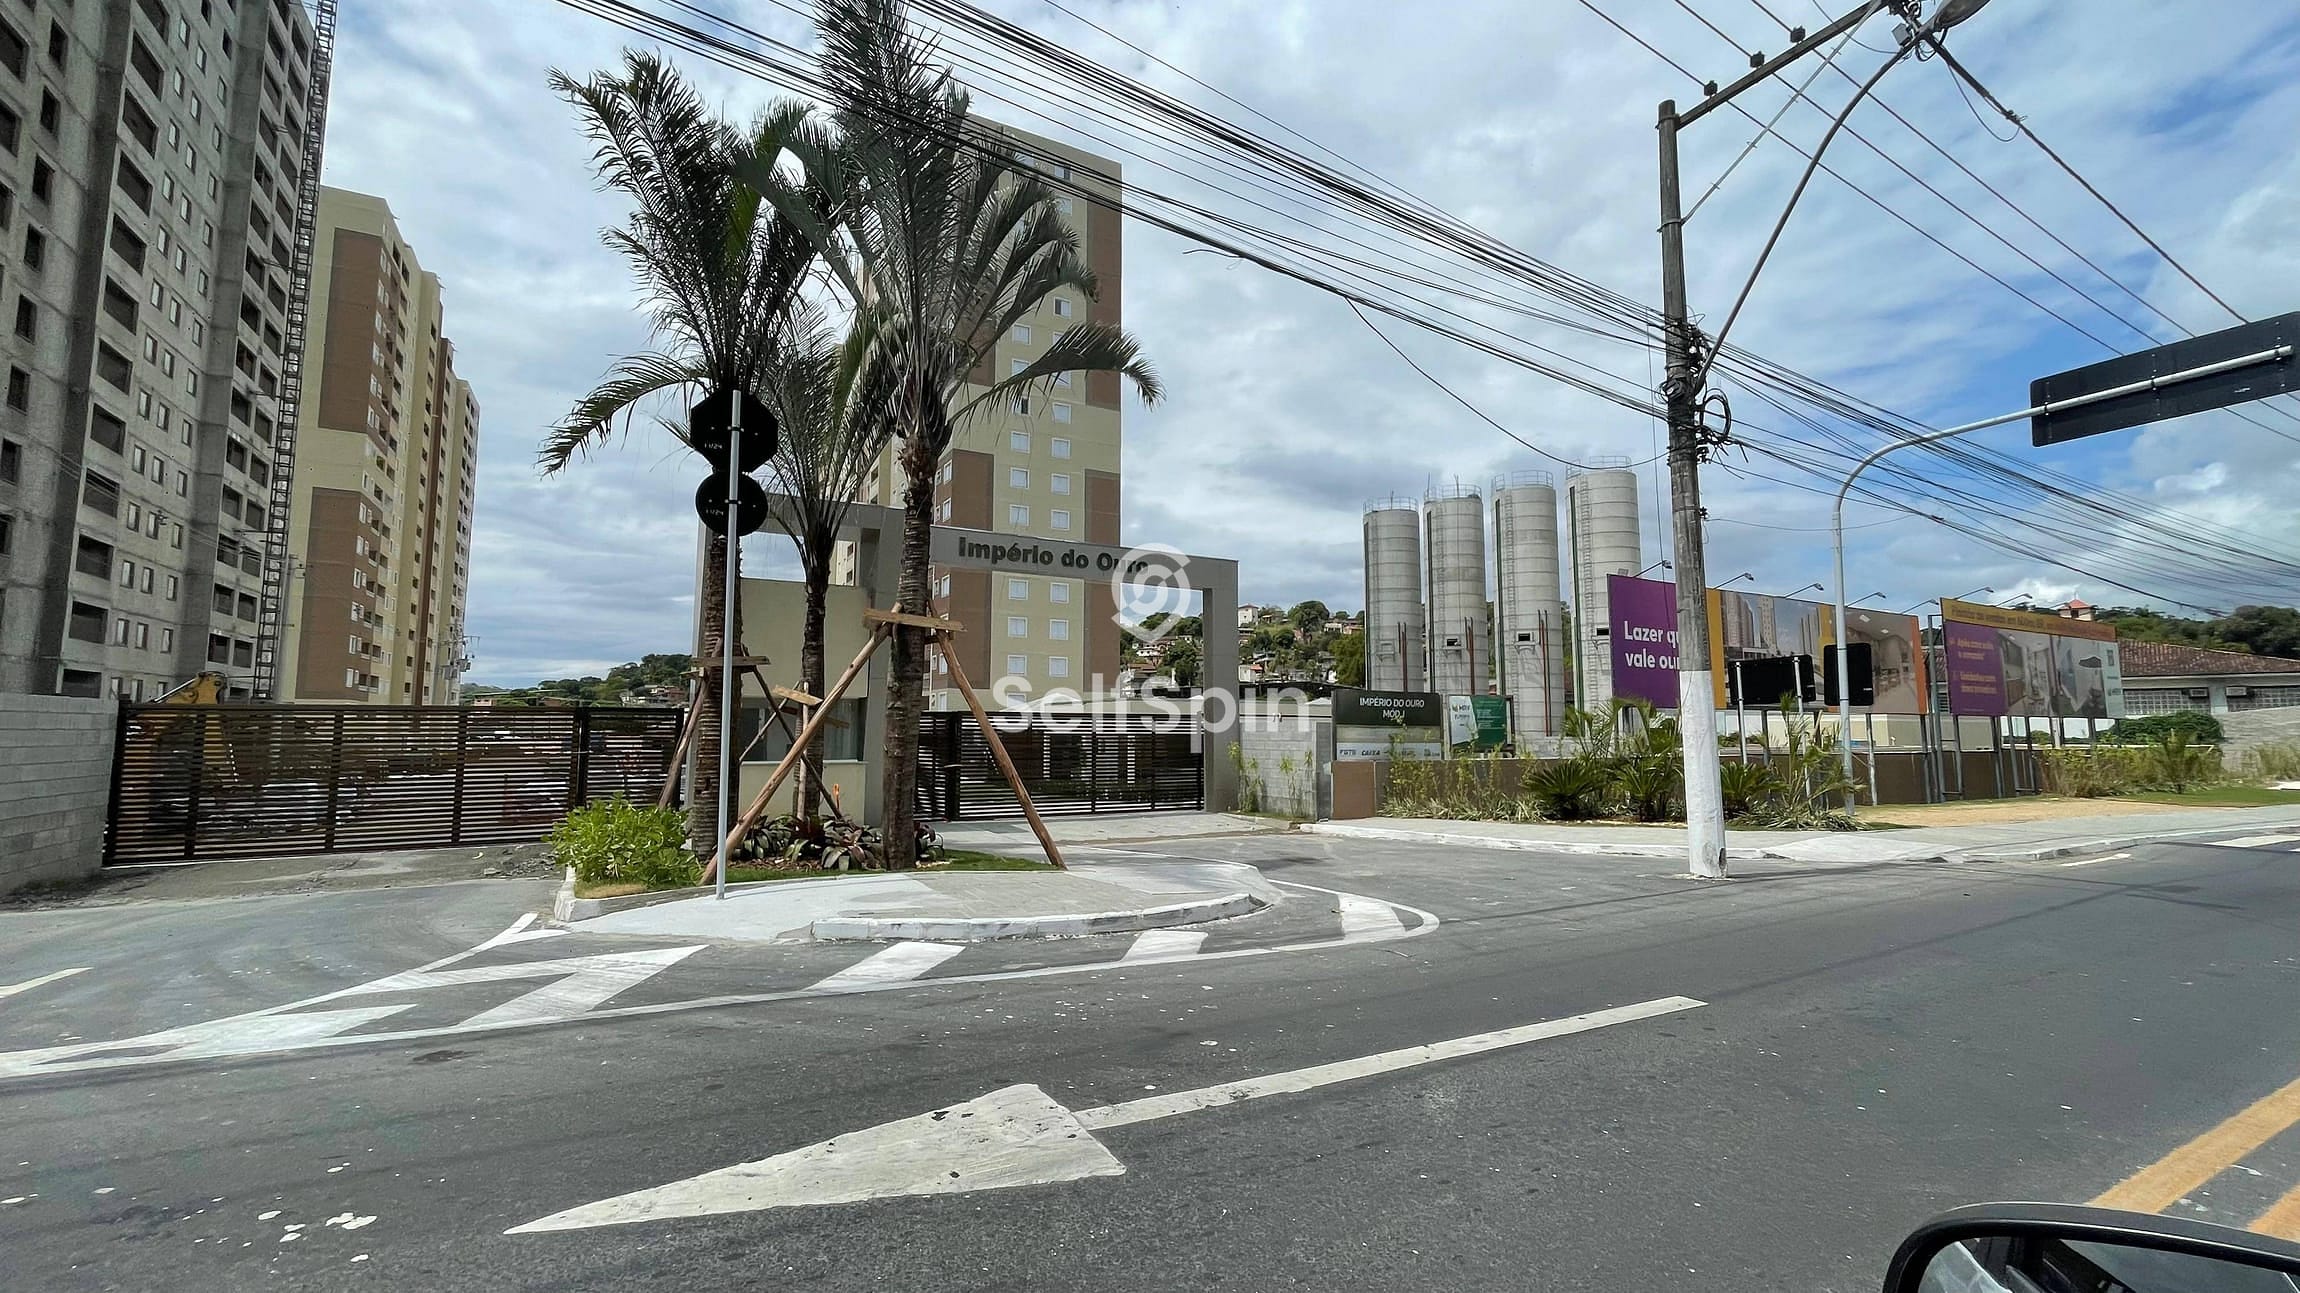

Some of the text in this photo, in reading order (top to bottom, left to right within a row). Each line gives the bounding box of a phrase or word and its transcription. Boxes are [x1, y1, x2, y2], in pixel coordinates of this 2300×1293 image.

[959, 537, 1054, 565] Império
[1061, 549, 1089, 569] do
[1624, 620, 1663, 642] Lazer
[1625, 648, 1655, 668] vale
[1360, 696, 1425, 708] IMPÉRIO DO OURO
